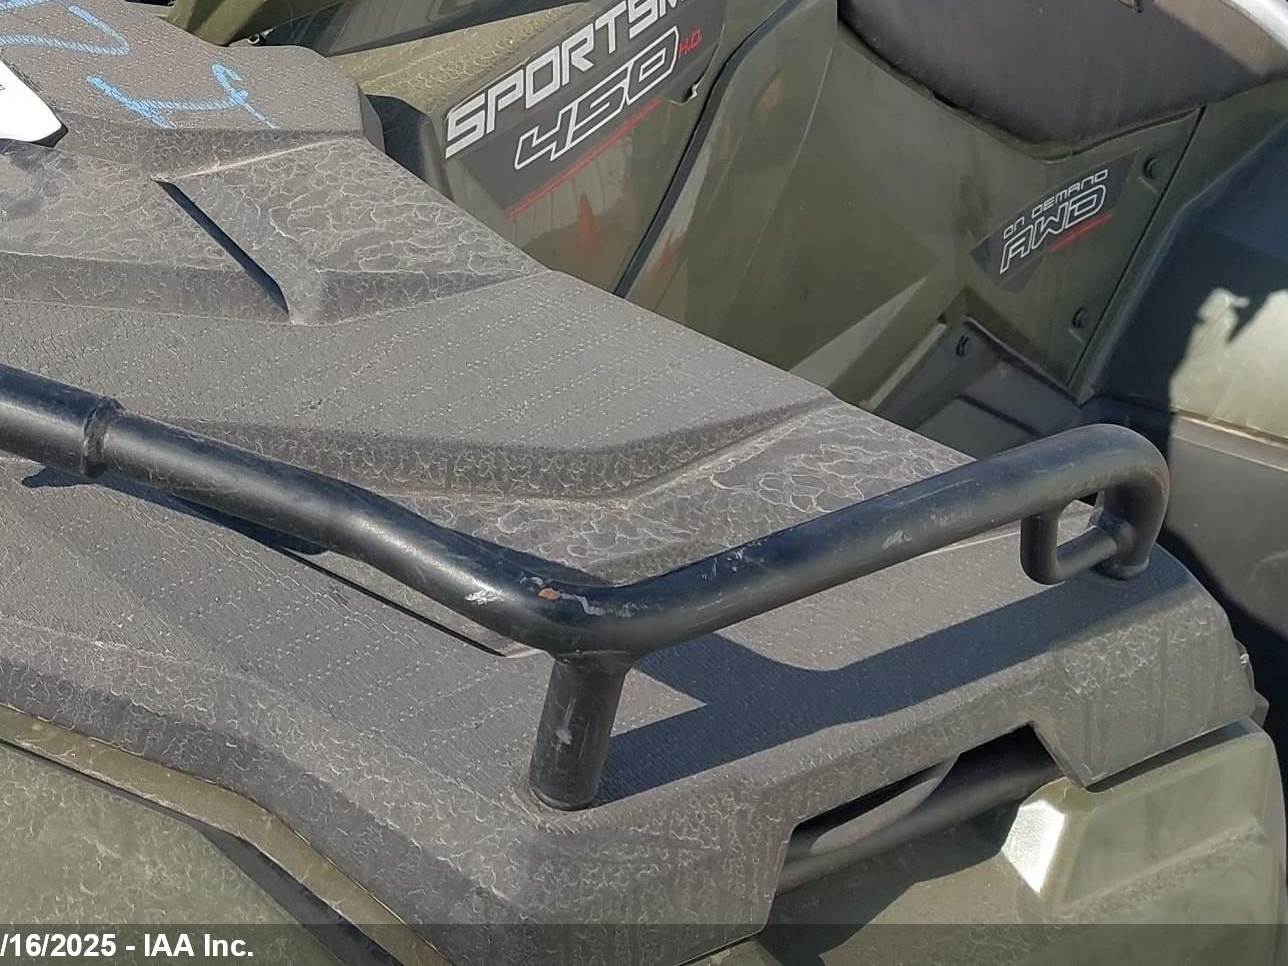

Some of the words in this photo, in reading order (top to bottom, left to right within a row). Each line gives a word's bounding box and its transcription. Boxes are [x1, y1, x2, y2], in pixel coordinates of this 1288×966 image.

[514, 25, 680, 170] 450
[1000, 184, 1106, 274] AWD
[1003, 216, 1025, 240] ON
[1031, 169, 1109, 219] DEMAND
